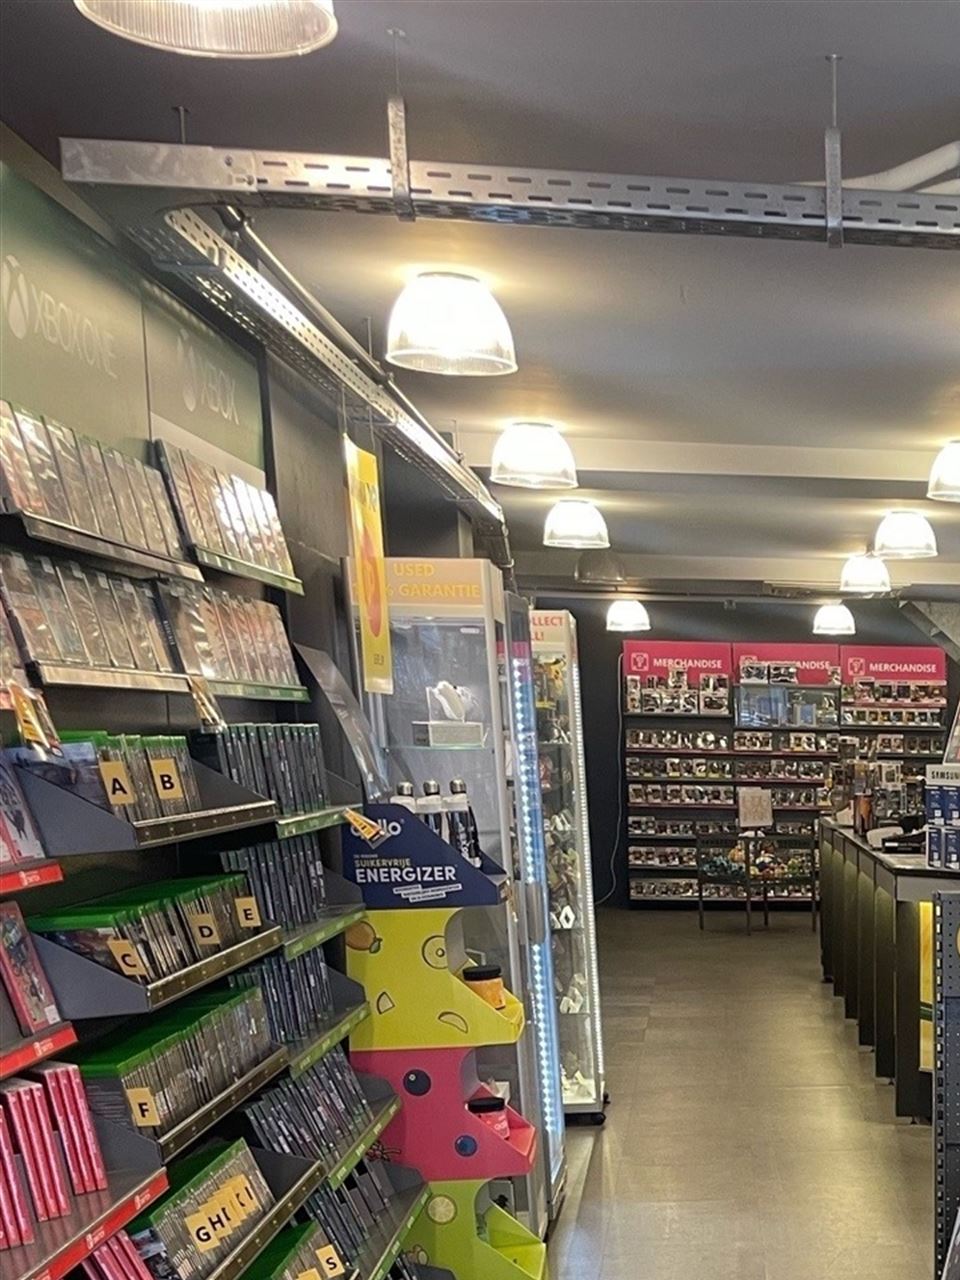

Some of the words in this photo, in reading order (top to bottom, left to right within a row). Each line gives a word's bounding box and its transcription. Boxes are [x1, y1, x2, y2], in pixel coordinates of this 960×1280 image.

[393, 563, 434, 577] USED
[399, 584, 480, 598] GARANTIE
[653, 658, 722, 669] MERCHANDISE
[869, 662, 937, 674] MERCHANDISE
[111, 777, 128, 795] A
[160, 774, 175, 791] B
[354, 857, 411, 869] SUIKERVRIJE
[356, 866, 457, 883] ENERGIZER
[244, 909, 254, 921] E
[200, 925, 213, 938] D
[121, 952, 137, 968] C
[139, 1102, 151, 1119] F
[195, 1226, 211, 1243] G
[208, 1214, 225, 1231] H
[326, 1257, 336, 1270] S
